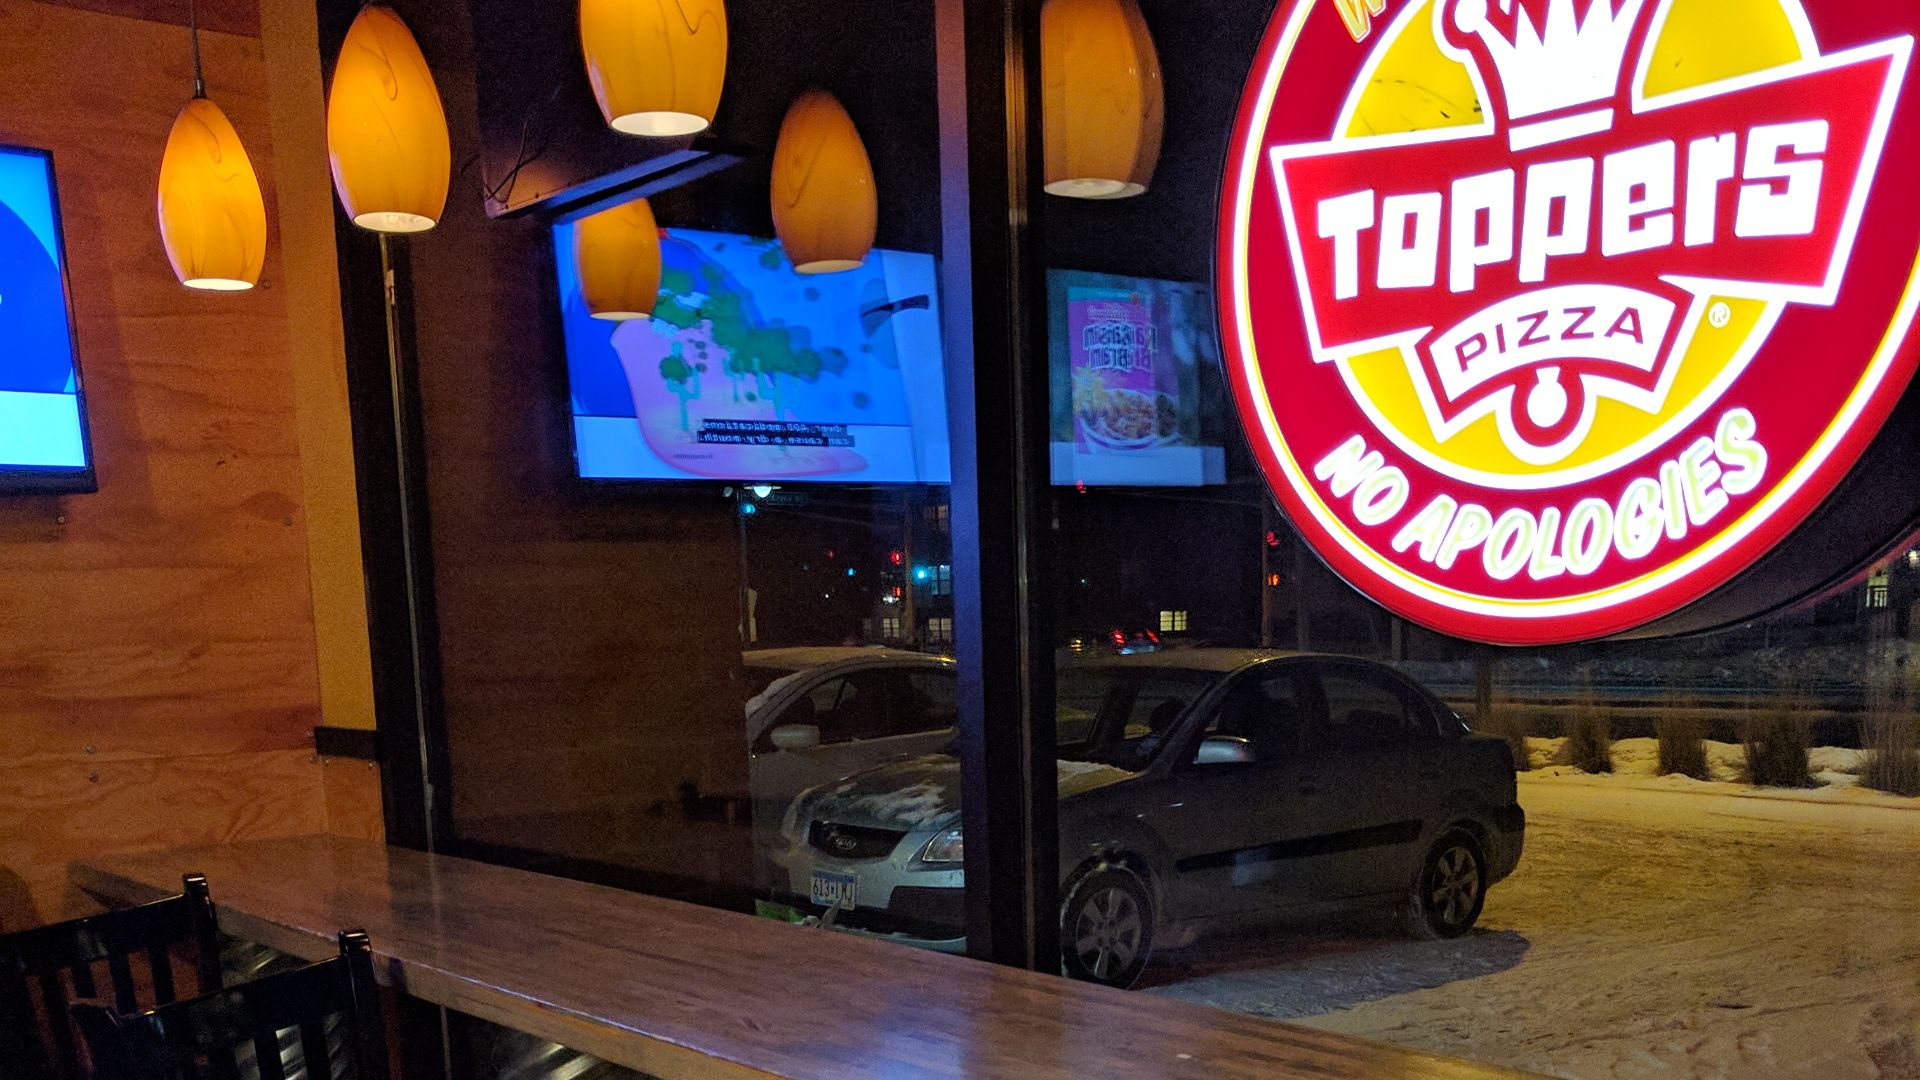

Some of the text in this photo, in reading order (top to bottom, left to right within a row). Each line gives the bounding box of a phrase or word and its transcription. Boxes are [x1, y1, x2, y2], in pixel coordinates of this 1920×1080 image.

[1318, 119, 1828, 300] Toppers
[1454, 306, 1643, 372] PIZZA
[1314, 407, 1768, 579] NO APOLOGIES
